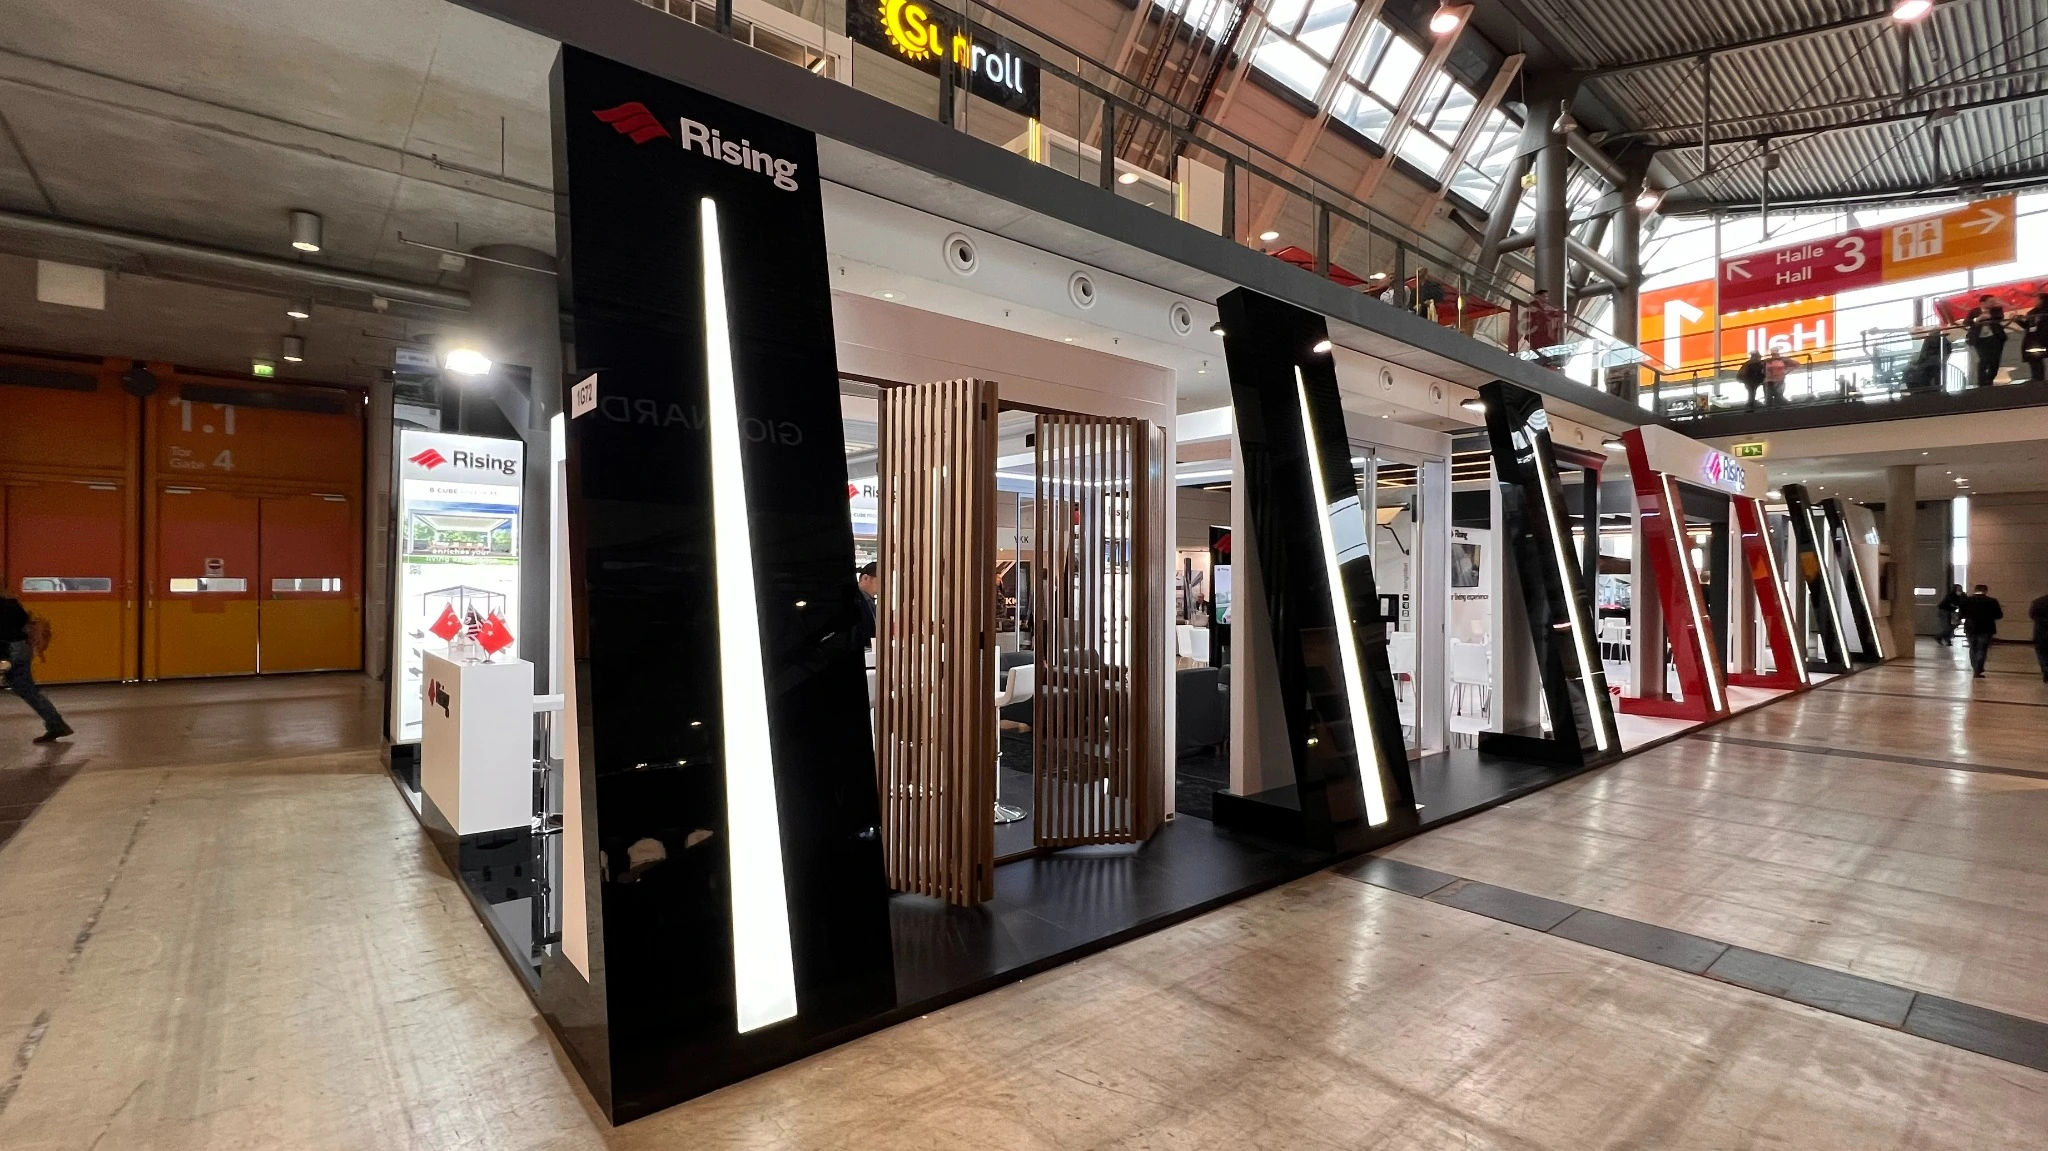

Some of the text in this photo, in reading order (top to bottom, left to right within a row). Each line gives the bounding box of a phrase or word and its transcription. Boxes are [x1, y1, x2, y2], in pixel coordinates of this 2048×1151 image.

[680, 116, 799, 192] Rising
[1776, 246, 1824, 265] Halle
[1834, 236, 1866, 273] 3
[1776, 267, 1812, 285] Hall
[576, 383, 593, 407] 1G72
[168, 397, 235, 435] 1.1
[212, 449, 235, 472] 4
[453, 450, 517, 475] Rising
[1723, 456, 1745, 491] Rising
